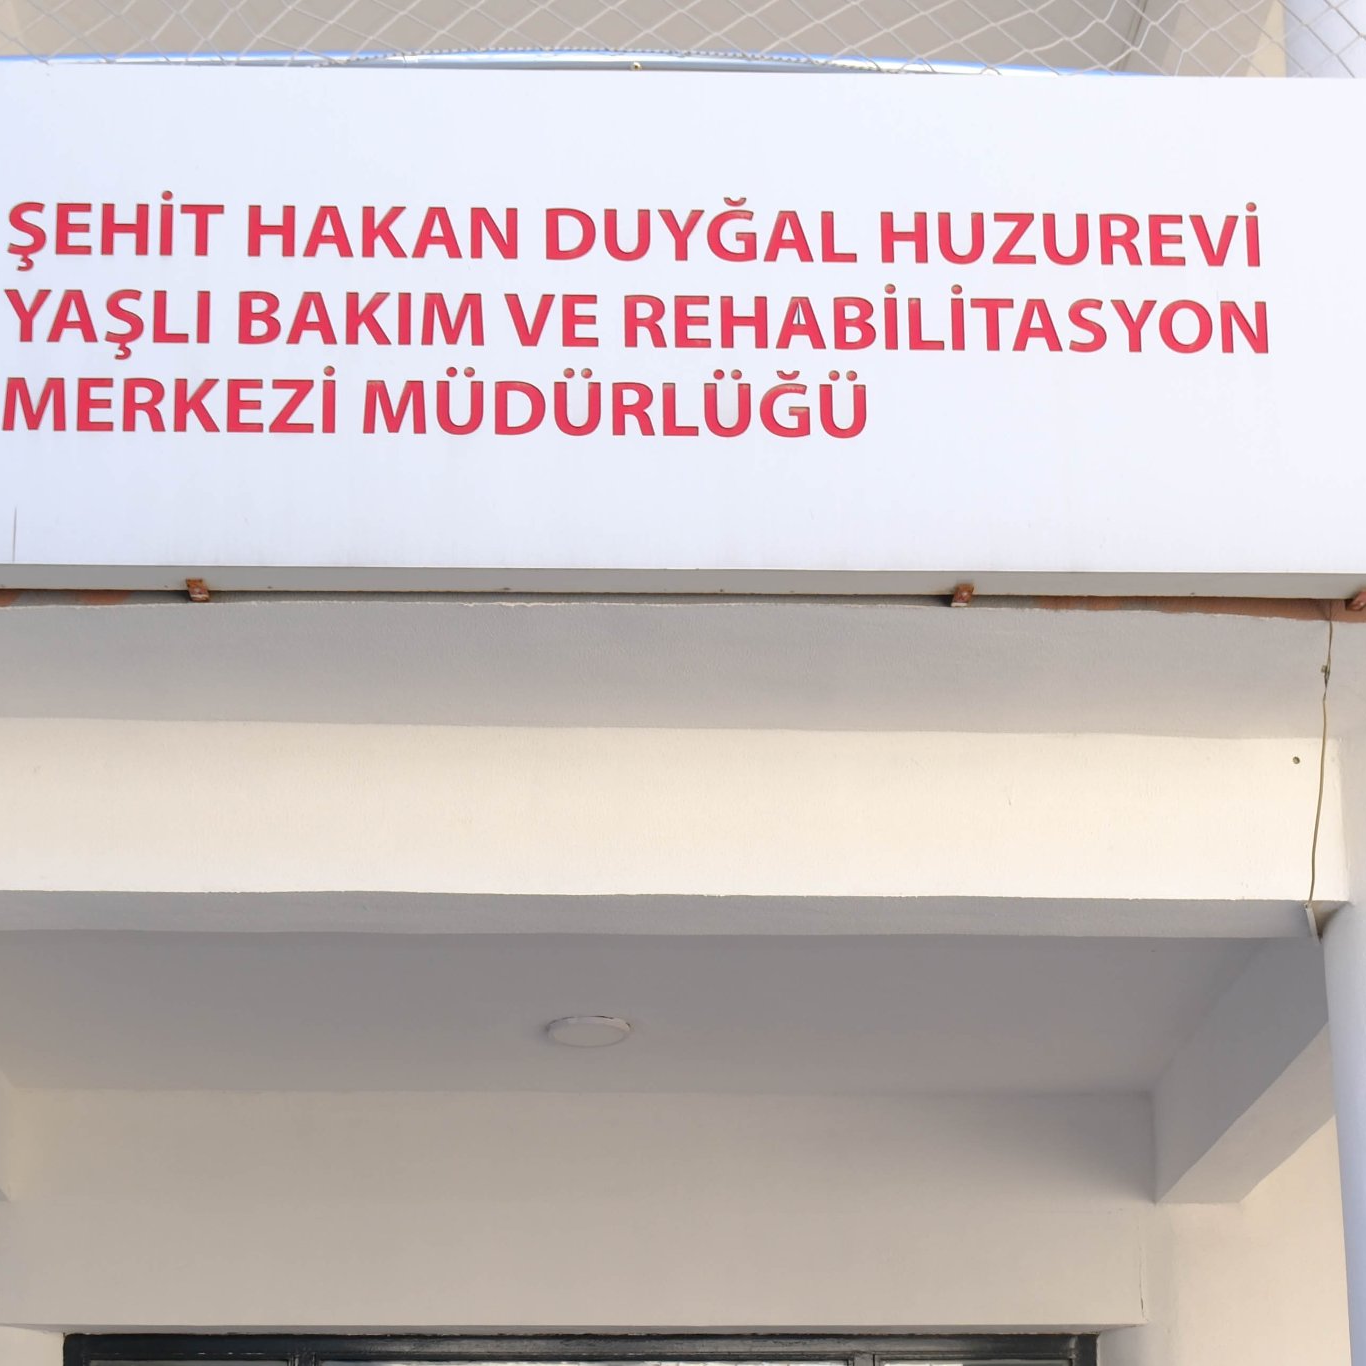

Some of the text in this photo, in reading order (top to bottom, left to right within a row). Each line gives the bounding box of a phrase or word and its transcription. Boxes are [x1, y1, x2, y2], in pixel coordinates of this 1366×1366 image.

[8, 190, 1261, 272] ŞEHİT HAKAN DUYĞAL HUZUREVİ
[4, 284, 1270, 361] YAŞLI BAKIM VE REHABİLİTASYON
[1, 365, 868, 440] MERKEZİ MÜDÜRLÜĞÜ
